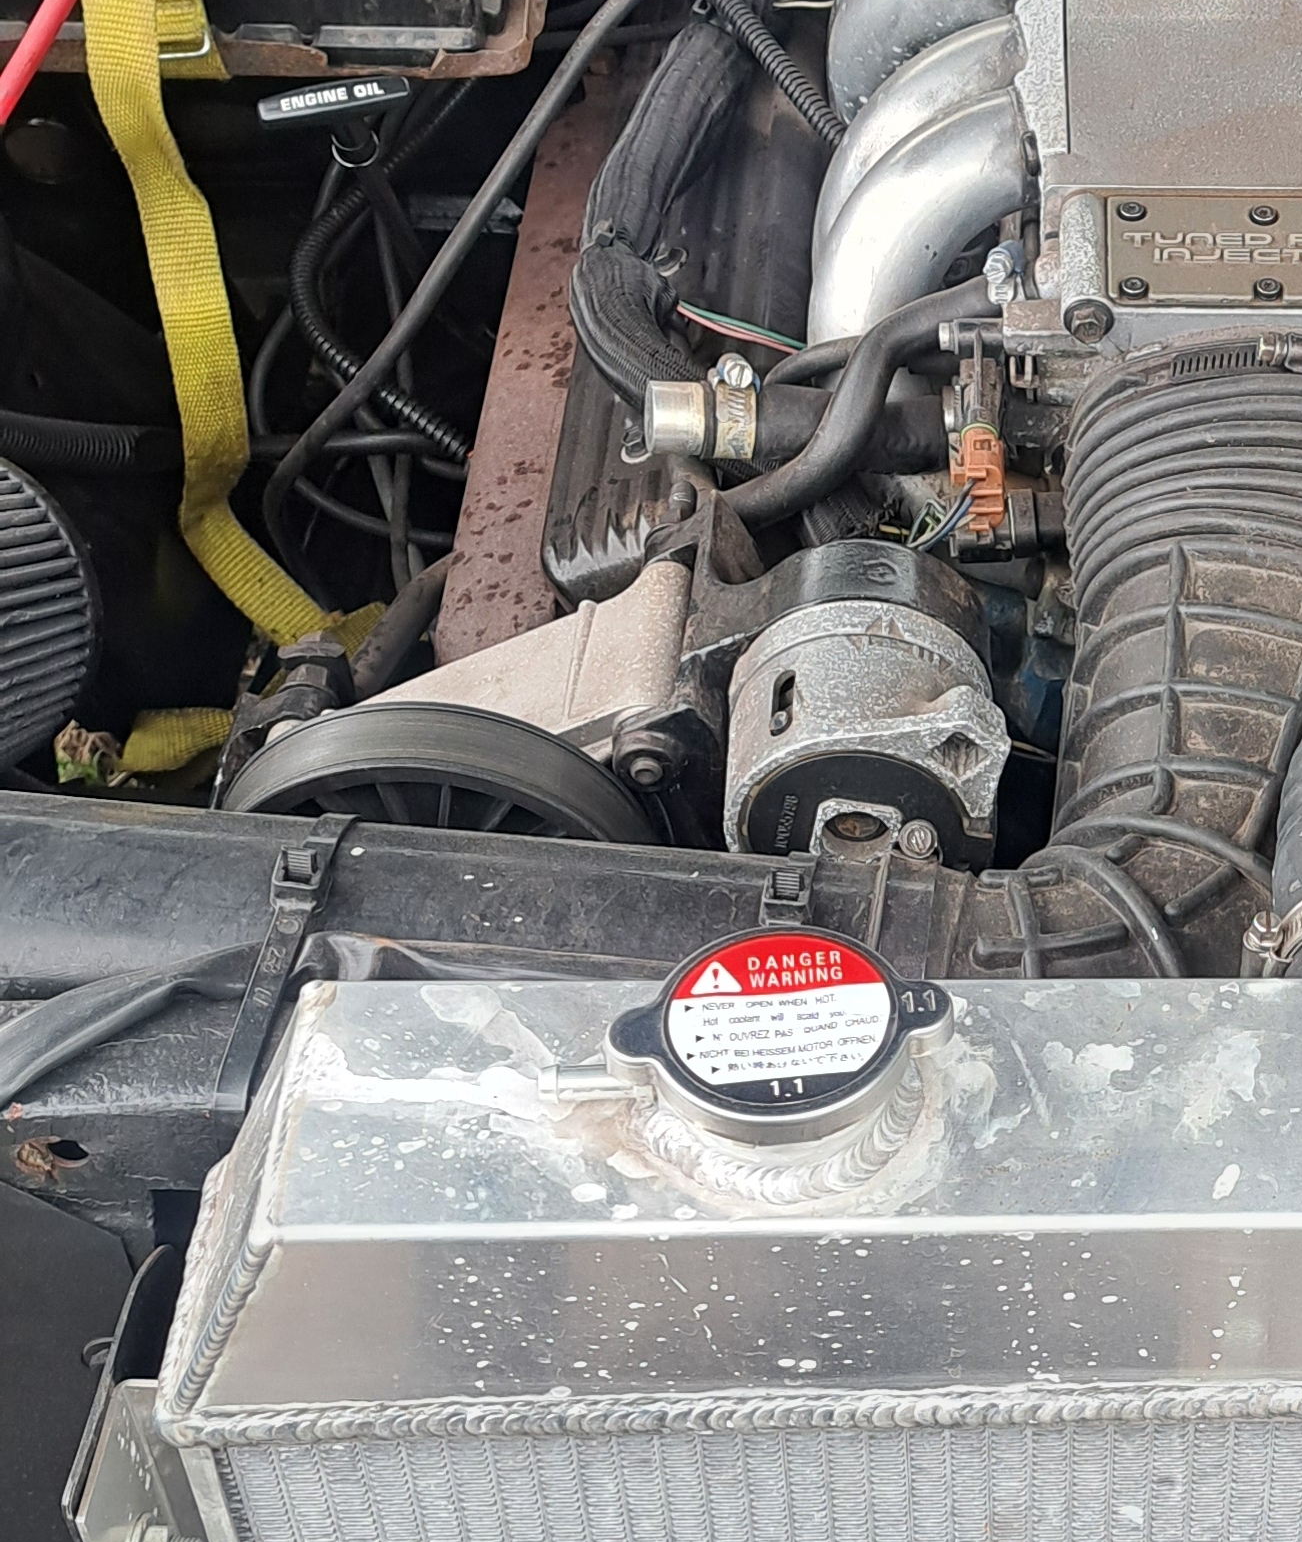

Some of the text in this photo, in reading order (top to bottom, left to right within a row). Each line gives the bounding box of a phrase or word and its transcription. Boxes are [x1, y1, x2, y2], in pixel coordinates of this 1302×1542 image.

[280, 82, 385, 111] ENGINE OIL
[1123, 232, 1273, 248] TUNED
[748, 951, 841, 970] DANGER
[749, 967, 843, 988] WARNING
[702, 1002, 735, 1011] NEVER
[746, 1000, 773, 1008] OPEN
[779, 998, 807, 1006] WHEN
[901, 989, 936, 1013] 1.1
[729, 1030, 770, 1041] OUVREZ
[775, 1029, 793, 1038] PAS
[804, 1022, 837, 1033] QUAND
[700, 1049, 729, 1059] NICHT
[753, 1046, 795, 1056] HEISSEM
[798, 1040, 833, 1052] MOTOR
[769, 1078, 804, 1097] 1.1
